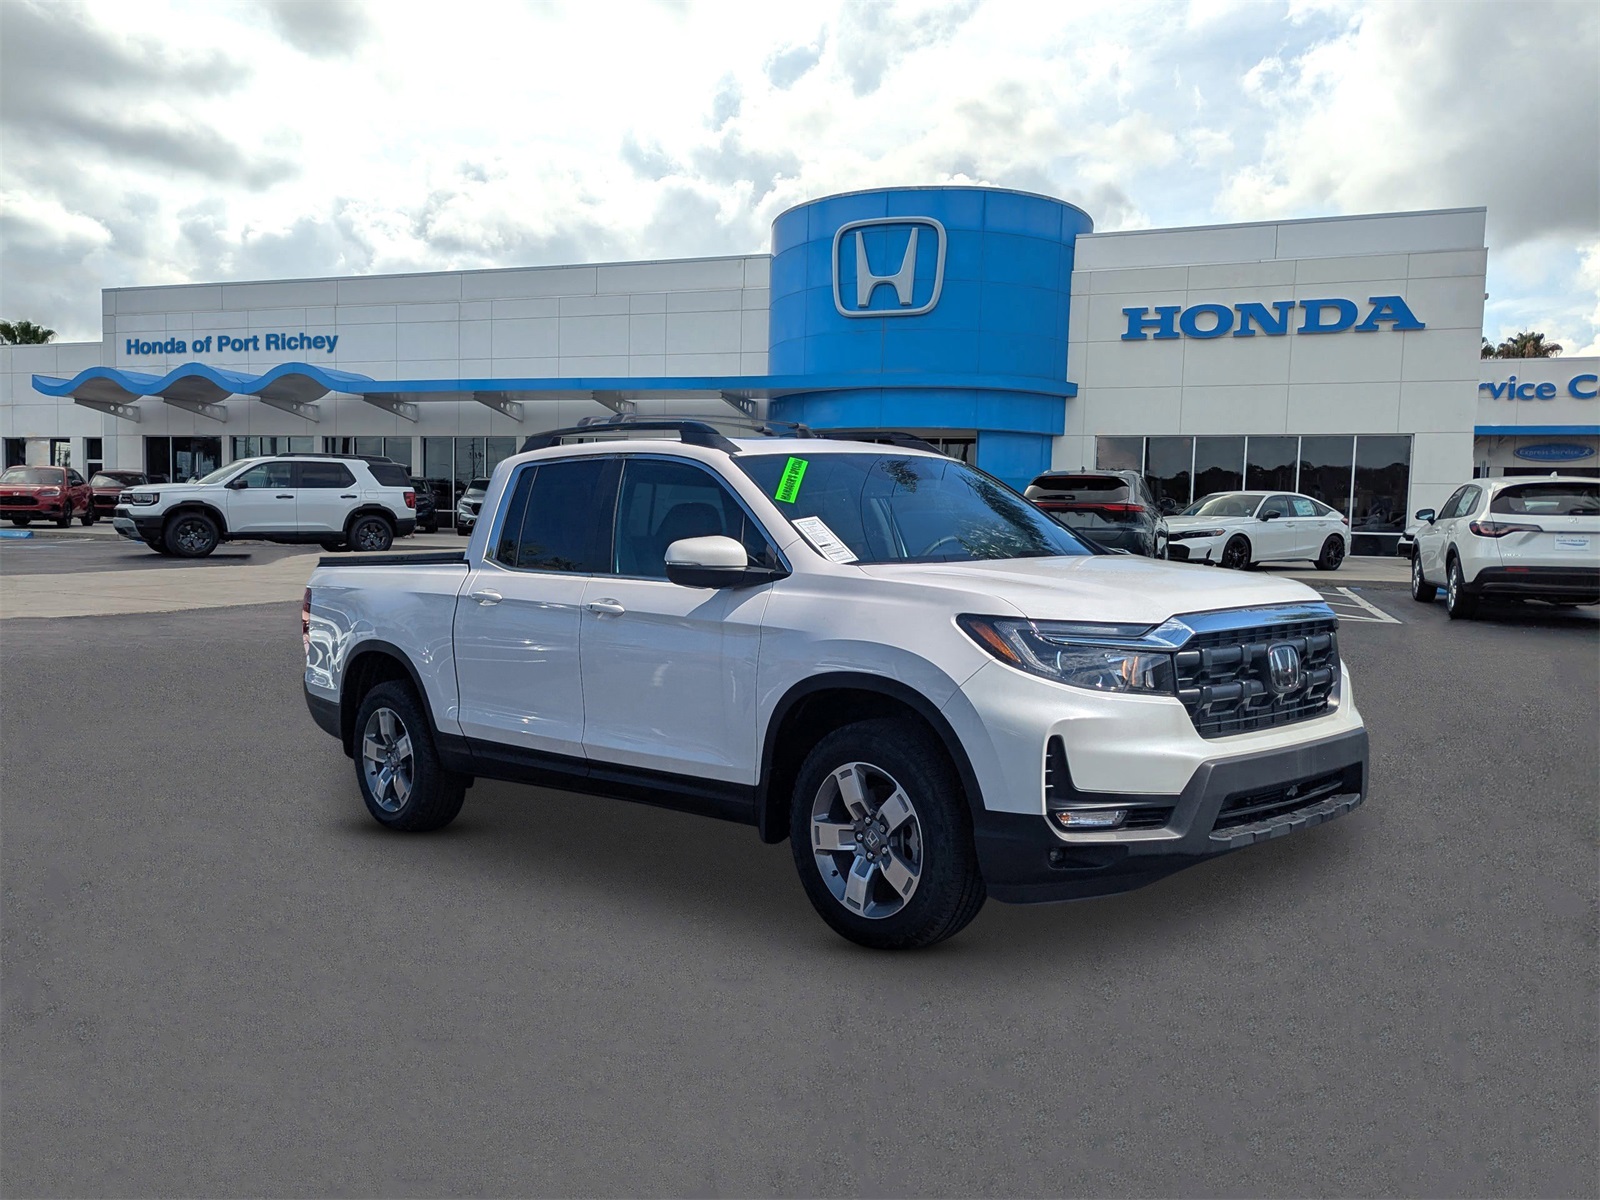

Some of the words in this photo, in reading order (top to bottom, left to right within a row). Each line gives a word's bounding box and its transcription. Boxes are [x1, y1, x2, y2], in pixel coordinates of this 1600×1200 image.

[1120, 295, 1426, 340] HONDA
[126, 336, 187, 355] Honda
[191, 335, 213, 353] of
[217, 334, 260, 353] Port
[265, 332, 339, 354] Richey
[1568, 373, 1600, 400] C
